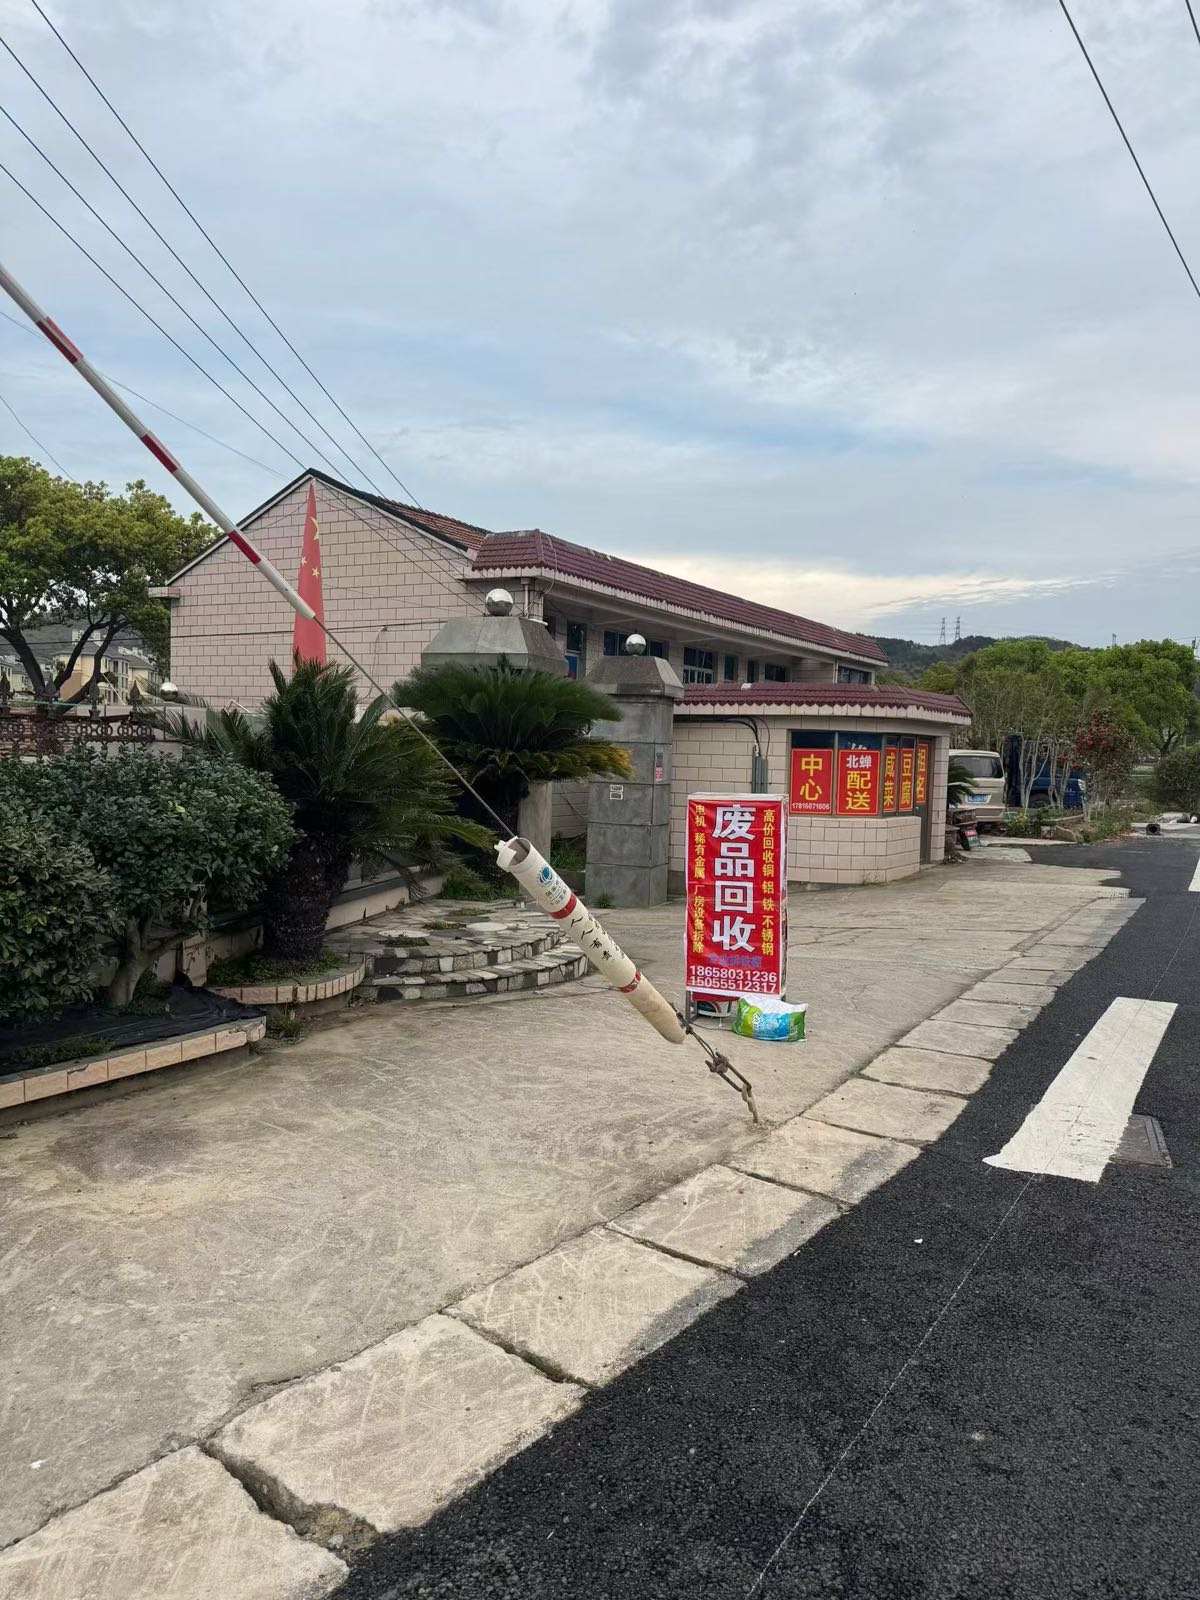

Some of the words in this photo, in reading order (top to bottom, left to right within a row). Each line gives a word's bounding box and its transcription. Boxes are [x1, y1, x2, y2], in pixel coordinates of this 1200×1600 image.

[800, 753, 823, 801] 中心
[846, 755, 872, 769] 北蝉
[883, 752, 895, 807] 咸菜
[900, 753, 911, 805] 豆腐
[845, 770, 872, 811] 配送
[694, 804, 706, 827] 电机
[694, 832, 706, 879] 稀有金属
[762, 809, 775, 878] 高价回收铜
[712, 804, 757, 952] 废品回收
[762, 881, 774, 894] 铝
[693, 885, 705, 954] 厂房设备拆除
[762, 898, 774, 911] 铁
[761, 915, 774, 956] 不锈钢
[688, 976, 777, 994] 15055512317
[690, 965, 778, 983] 18658031236
